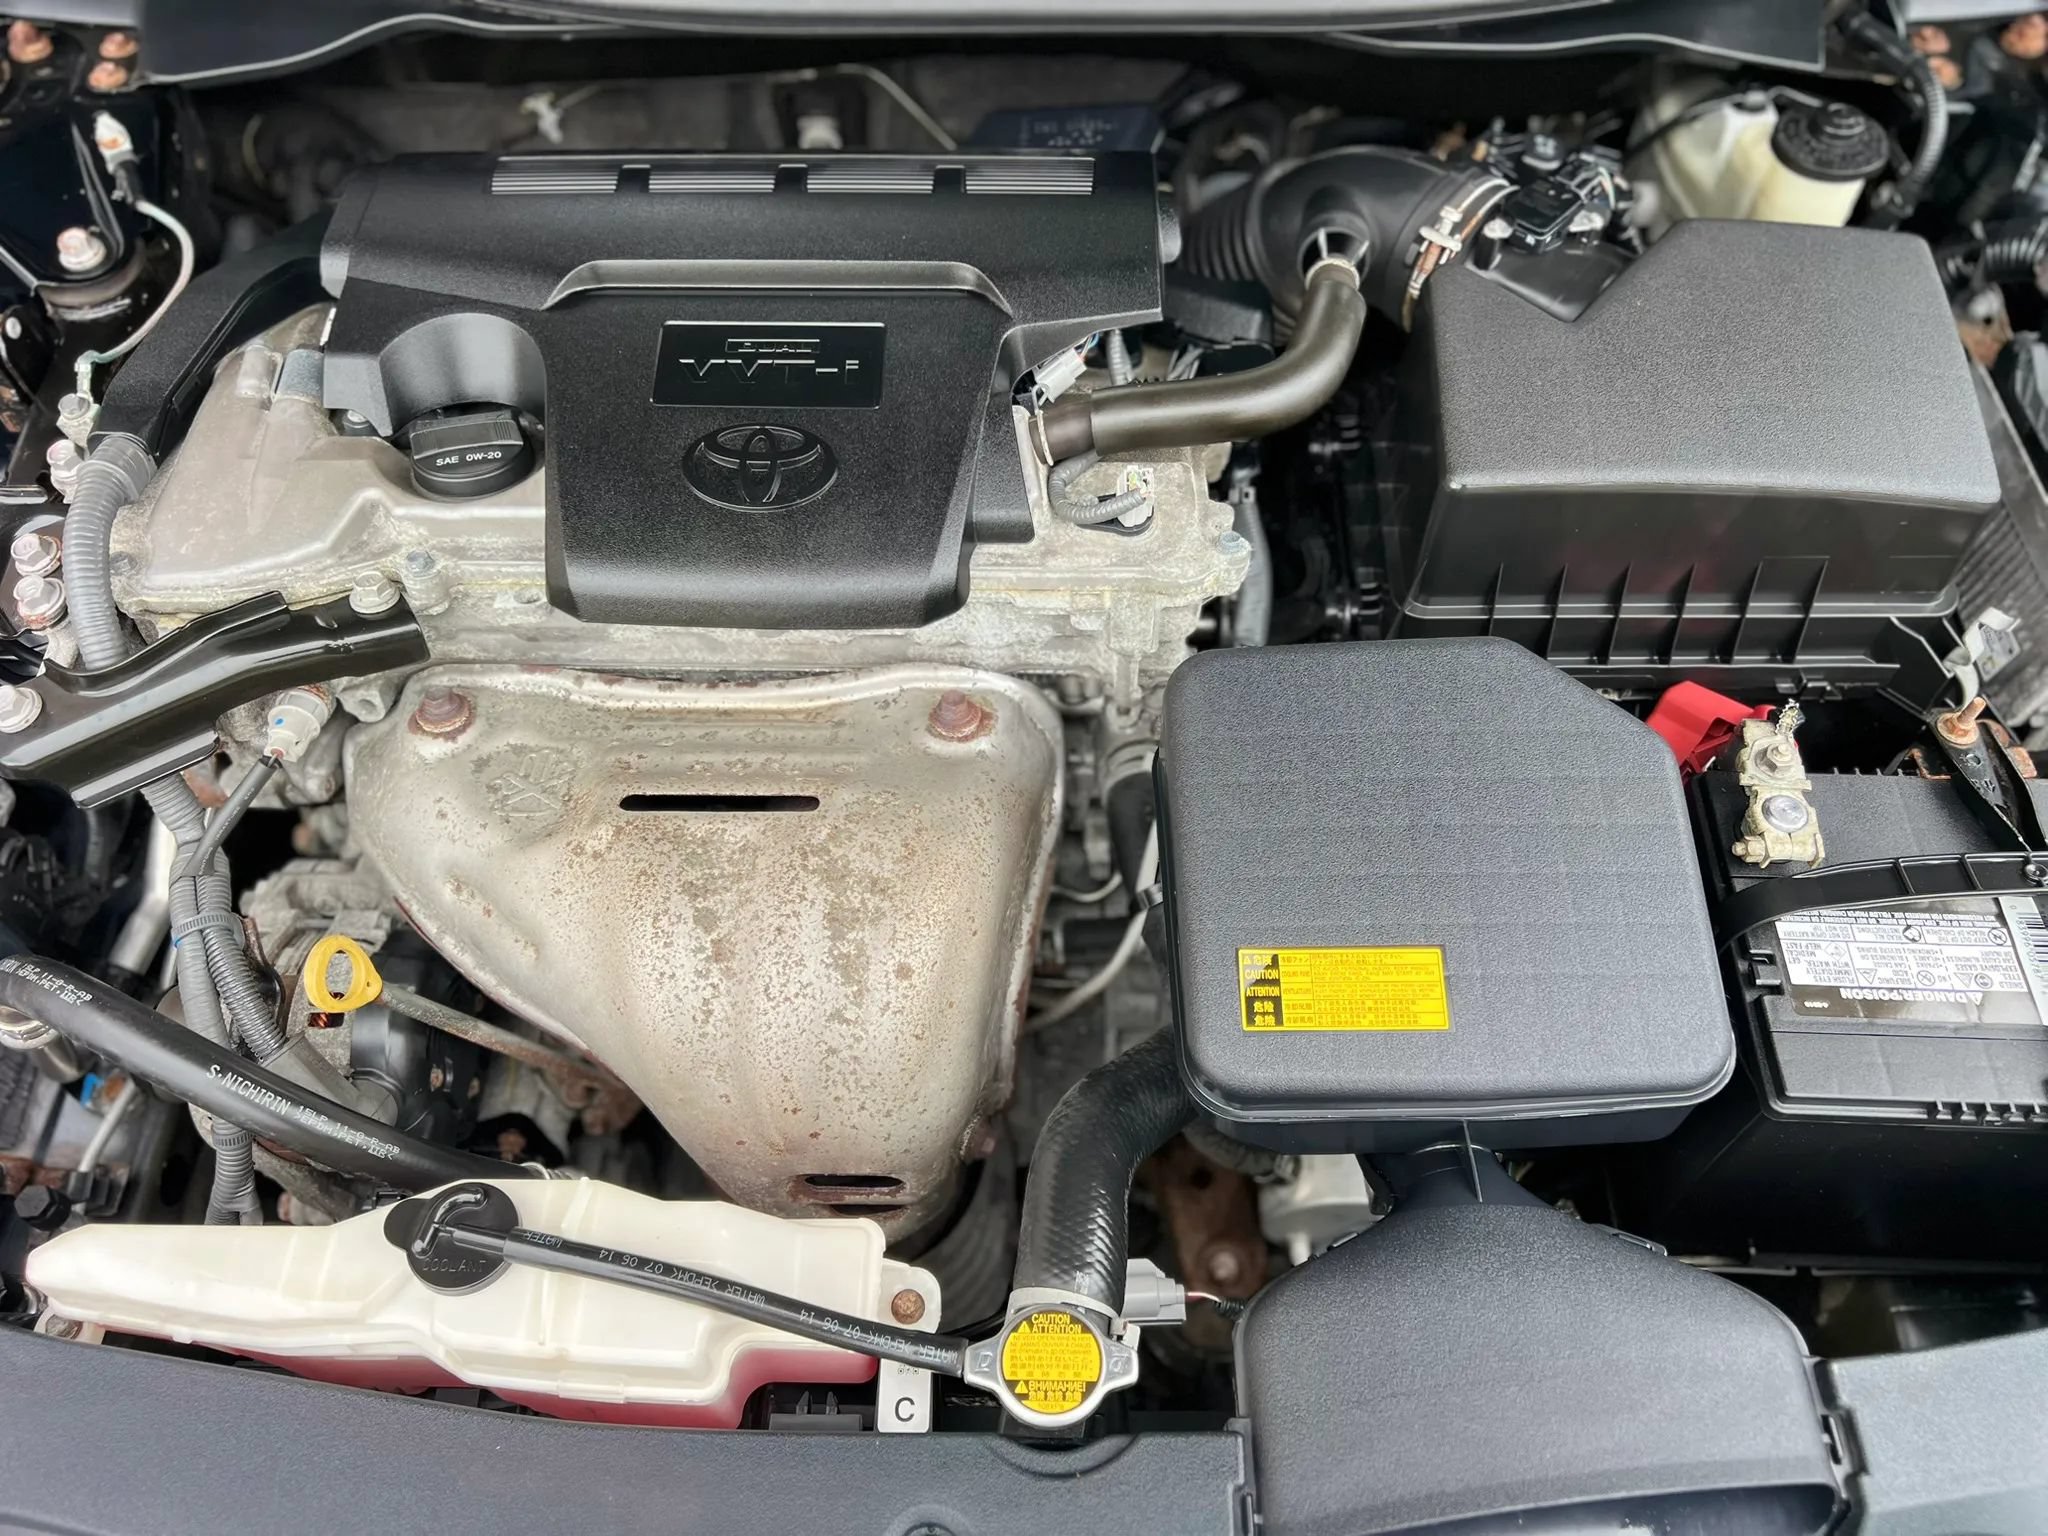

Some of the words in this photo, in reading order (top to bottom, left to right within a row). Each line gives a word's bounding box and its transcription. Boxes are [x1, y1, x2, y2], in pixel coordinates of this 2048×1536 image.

[435, 455, 460, 466] SAE
[465, 451, 502, 462] 0W-20
[1245, 969, 1279, 980] CAUTION
[1246, 986, 1280, 997] ATTENTION
[523, 1230, 563, 1248] WATER
[599, 1249, 615, 1261] 14
[621, 1254, 639, 1267] 06
[422, 1258, 487, 1272] COOLANT
[644, 1261, 664, 1274] 07
[725, 1284, 766, 1307] WATER
[799, 1308, 816, 1325] 14
[1031, 1313, 1071, 1325] CAUTION
[822, 1317, 839, 1333] 06
[1031, 1324, 1082, 1334] ATTENTION
[843, 1325, 861, 1340] 07
[918, 1343, 958, 1365] WATER
[1028, 1380, 1087, 1392] ВНИМАНИЕ!
[894, 1396, 916, 1422] C
